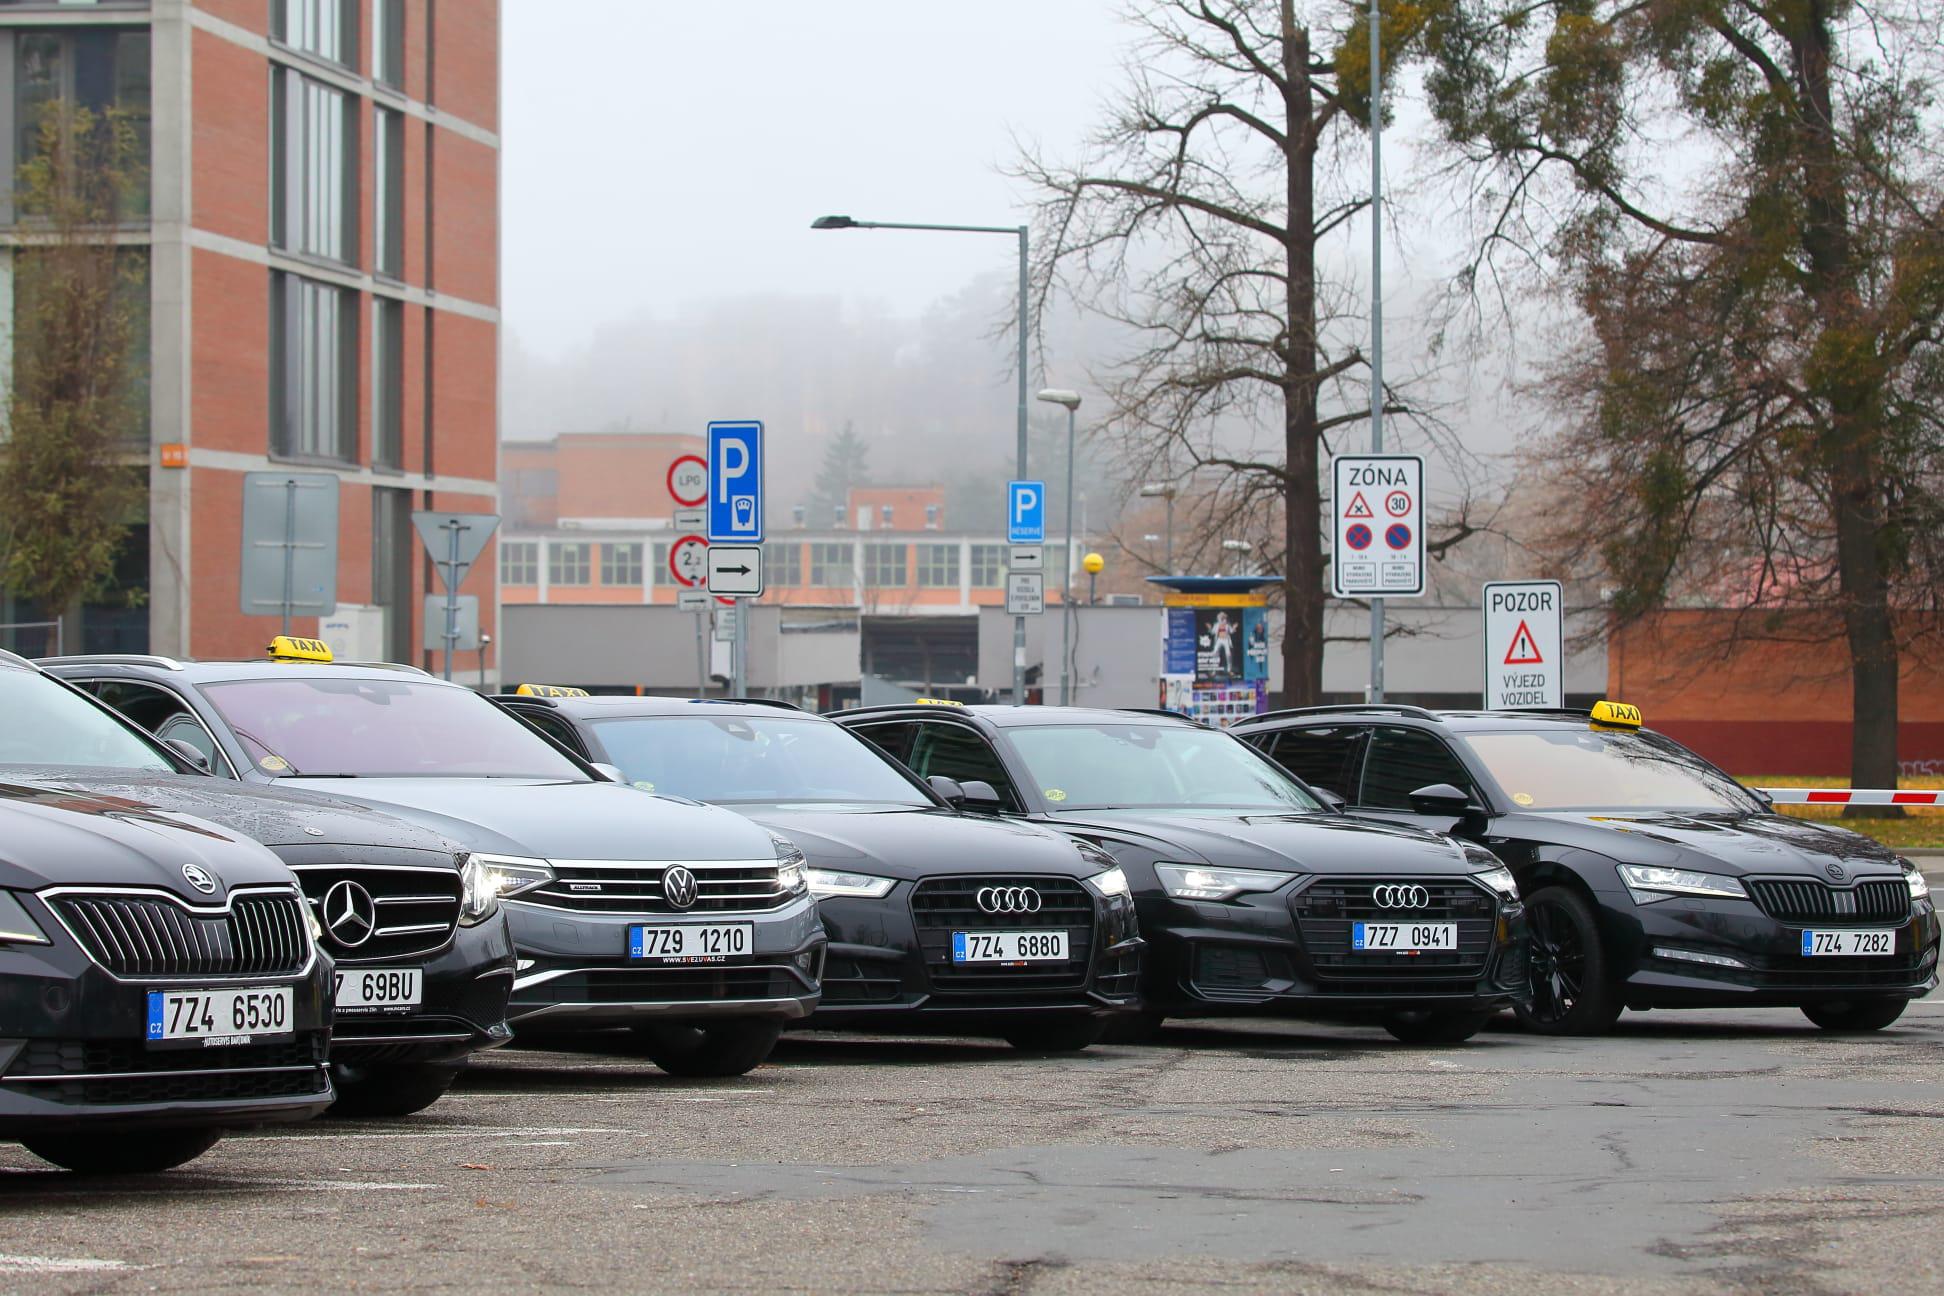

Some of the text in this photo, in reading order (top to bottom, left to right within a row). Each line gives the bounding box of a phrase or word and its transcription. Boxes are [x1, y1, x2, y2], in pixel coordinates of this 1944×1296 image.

[678, 475, 701, 486] LPG
[719, 438, 750, 504] P
[1349, 463, 1408, 486] ZÓNA
[1016, 488, 1037, 523] P
[1391, 498, 1405, 511] 30
[1492, 592, 1552, 612] POZOR
[287, 638, 327, 653] TAXI
[1503, 672, 1545, 689] VÝJEZD
[1501, 691, 1548, 705] VOZIDEL
[1605, 703, 1640, 721] TAXI
[647, 928, 744, 955] 7Z9 1210
[1368, 926, 1449, 947] 7Z7 0941
[1815, 934, 1888, 953] 7Z4 7282
[632, 946, 642, 954] CZ
[969, 935, 1060, 958] 7Z4 6880
[362, 972, 413, 1002] 69BU
[169, 992, 285, 1034] 7Z4 6530
[150, 1023, 162, 1033] CZ
